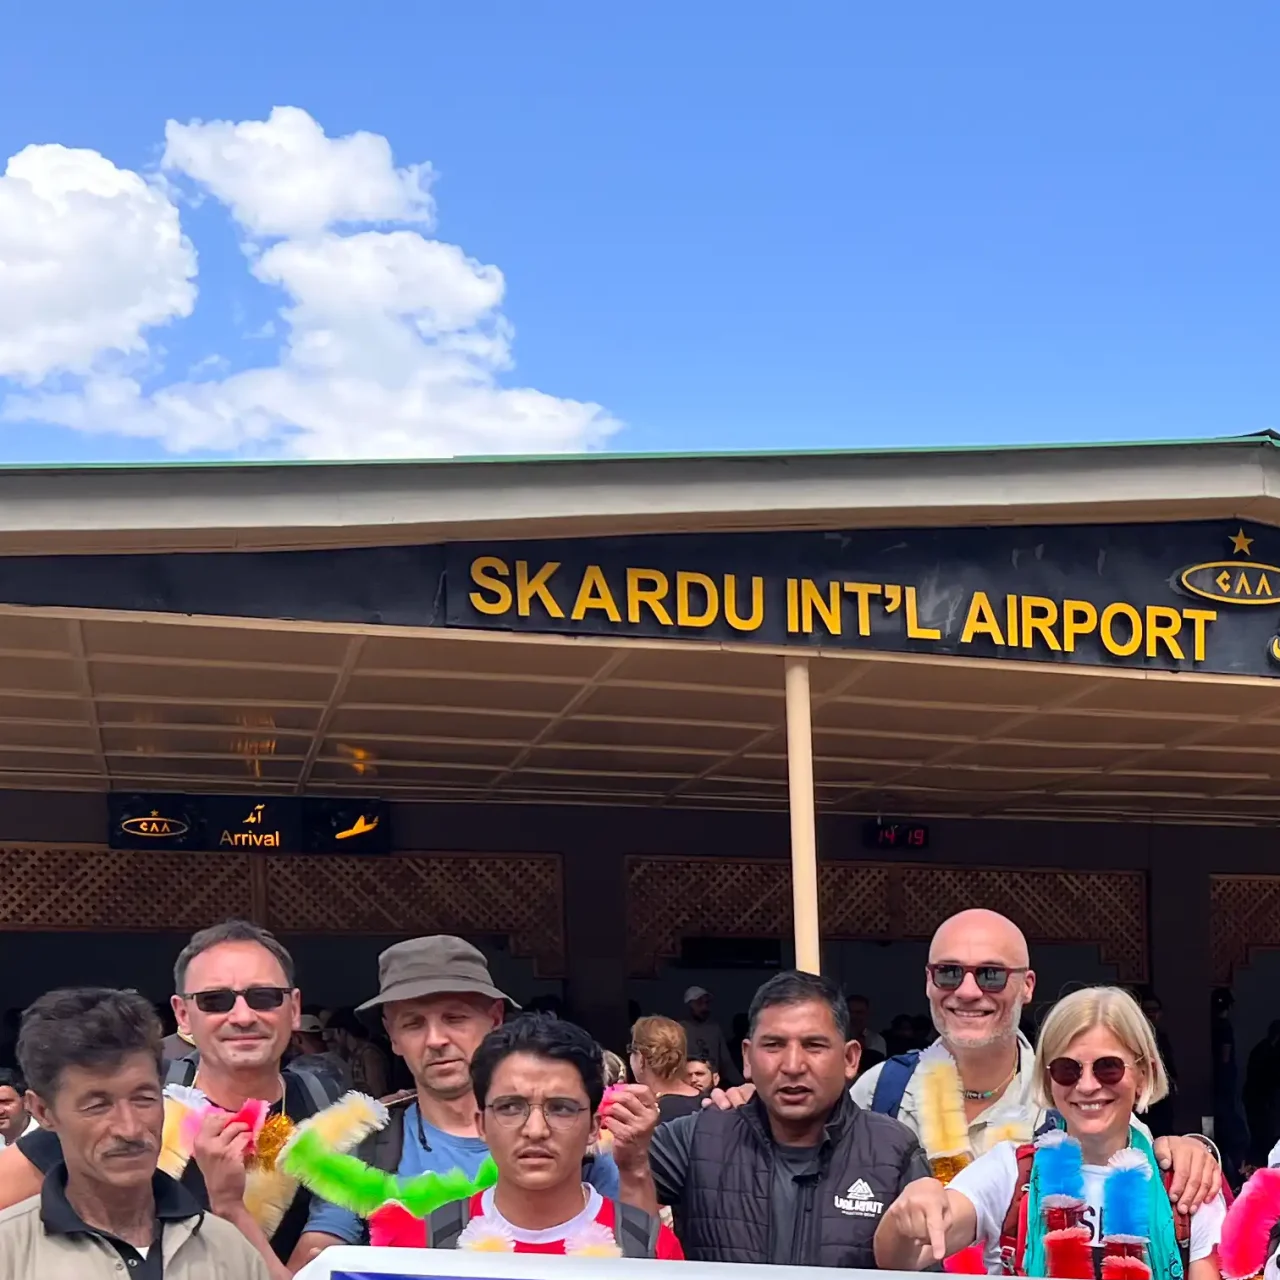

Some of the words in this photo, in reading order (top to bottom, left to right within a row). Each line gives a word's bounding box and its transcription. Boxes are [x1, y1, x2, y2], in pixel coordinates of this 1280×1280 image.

[469, 556, 764, 631] SKARDU
[961, 591, 1217, 661] AIRPORT
[219, 830, 280, 847] Arrival
